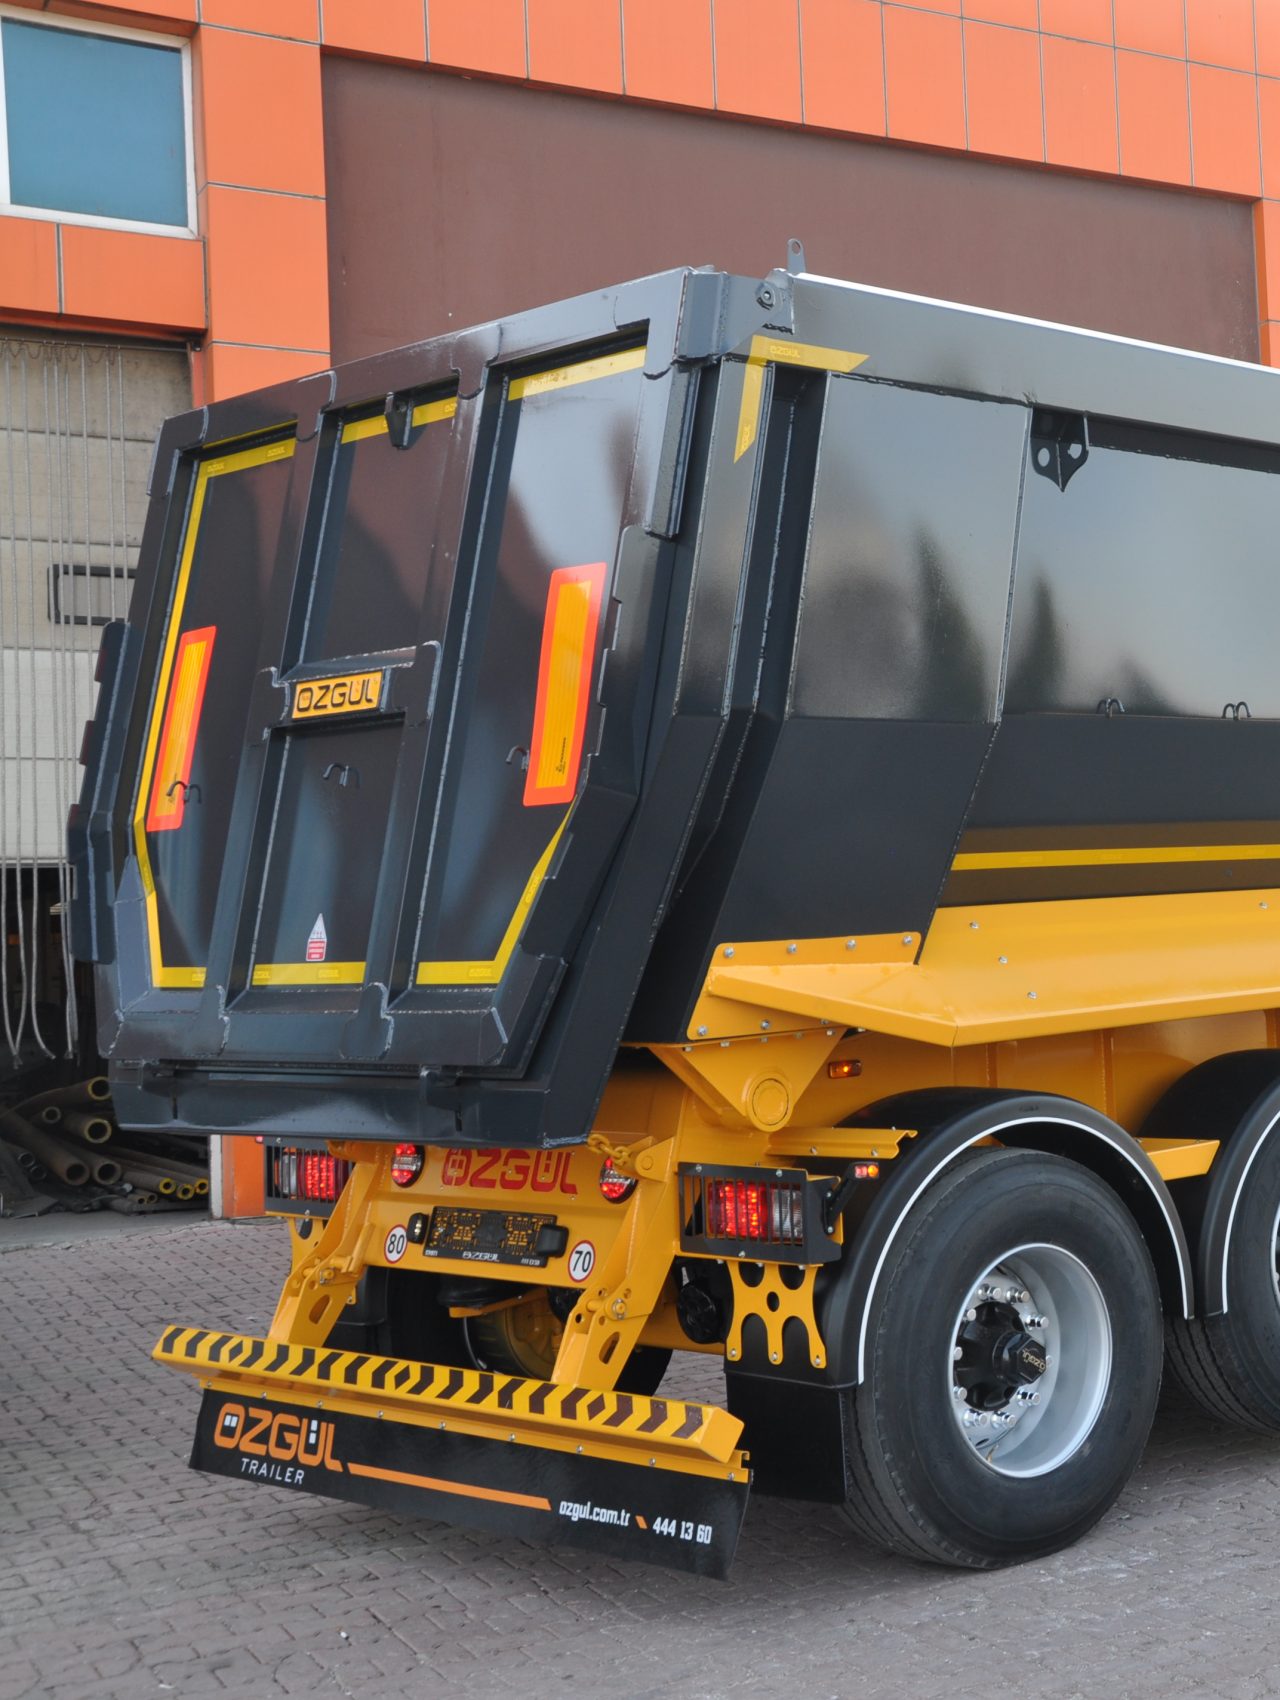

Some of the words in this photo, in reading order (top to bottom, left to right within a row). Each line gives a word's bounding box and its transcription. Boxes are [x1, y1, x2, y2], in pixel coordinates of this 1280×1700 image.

[387, 1233, 406, 1255] 80
[573, 1249, 592, 1273] 70
[214, 1402, 344, 1473] ÖZGÜL
[240, 1457, 305, 1485] TRAILER
[558, 1500, 631, 1528] ozgul.com.tr
[652, 1516, 677, 1537] 444
[680, 1520, 694, 1541] 13
[696, 1523, 713, 1545] 60
